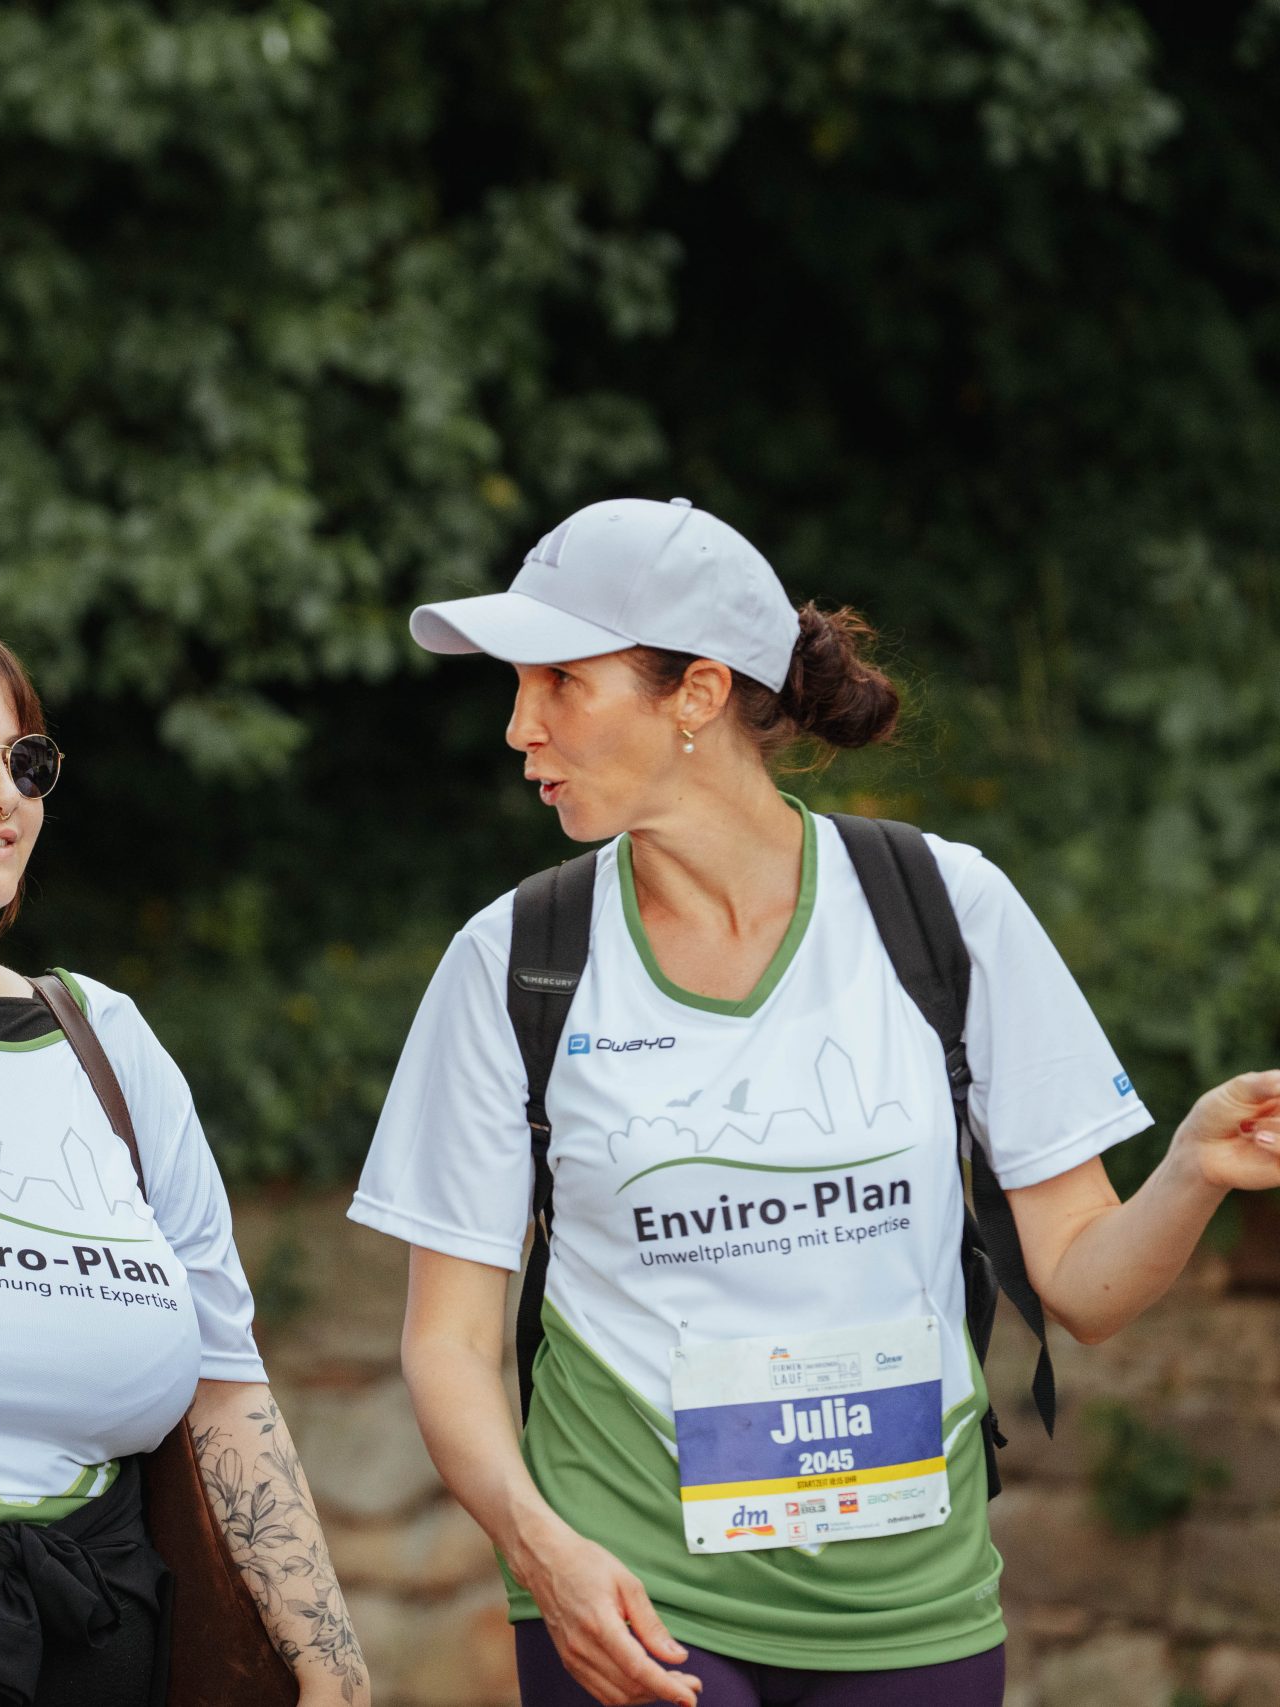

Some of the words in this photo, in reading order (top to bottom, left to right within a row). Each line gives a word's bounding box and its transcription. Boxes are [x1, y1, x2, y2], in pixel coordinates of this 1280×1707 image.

[633, 1176, 911, 1242] Enviro-Plan
[640, 1237, 791, 1266] Umweltplanung
[798, 1229, 829, 1248] mit
[835, 1216, 910, 1244] Expertise
[60, 1284, 95, 1299] mit
[100, 1286, 179, 1312] Expertise
[774, 1373, 803, 1386] LAUF
[770, 1398, 873, 1445] Julia
[799, 1448, 855, 1475] 2045
[732, 1505, 769, 1527] dm
